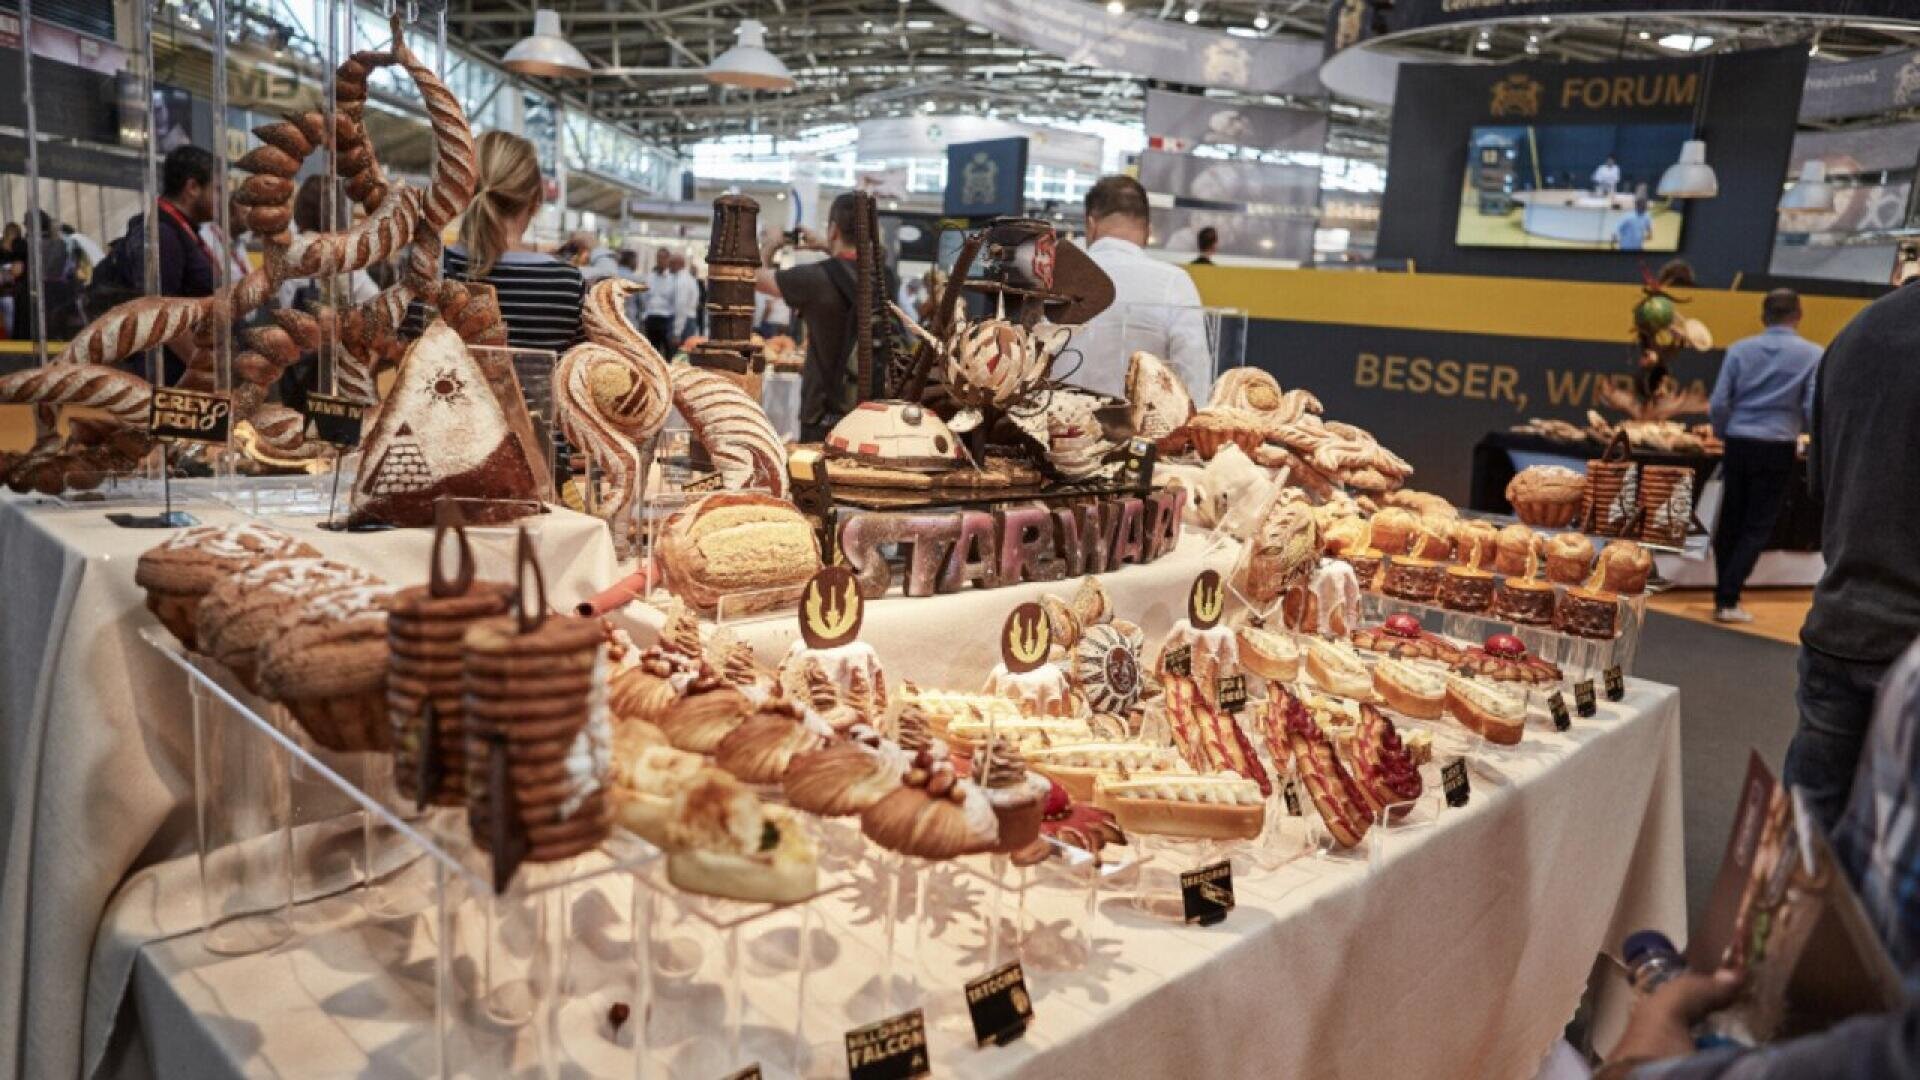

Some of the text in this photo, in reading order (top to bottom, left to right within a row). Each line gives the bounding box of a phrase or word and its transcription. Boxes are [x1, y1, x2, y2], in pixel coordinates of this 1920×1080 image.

[1561, 73, 1698, 109] FORUM
[1355, 353, 1528, 413] BESSER,
[842, 508, 1067, 600] STAR
[850, 1030, 924, 1069] FALCON
